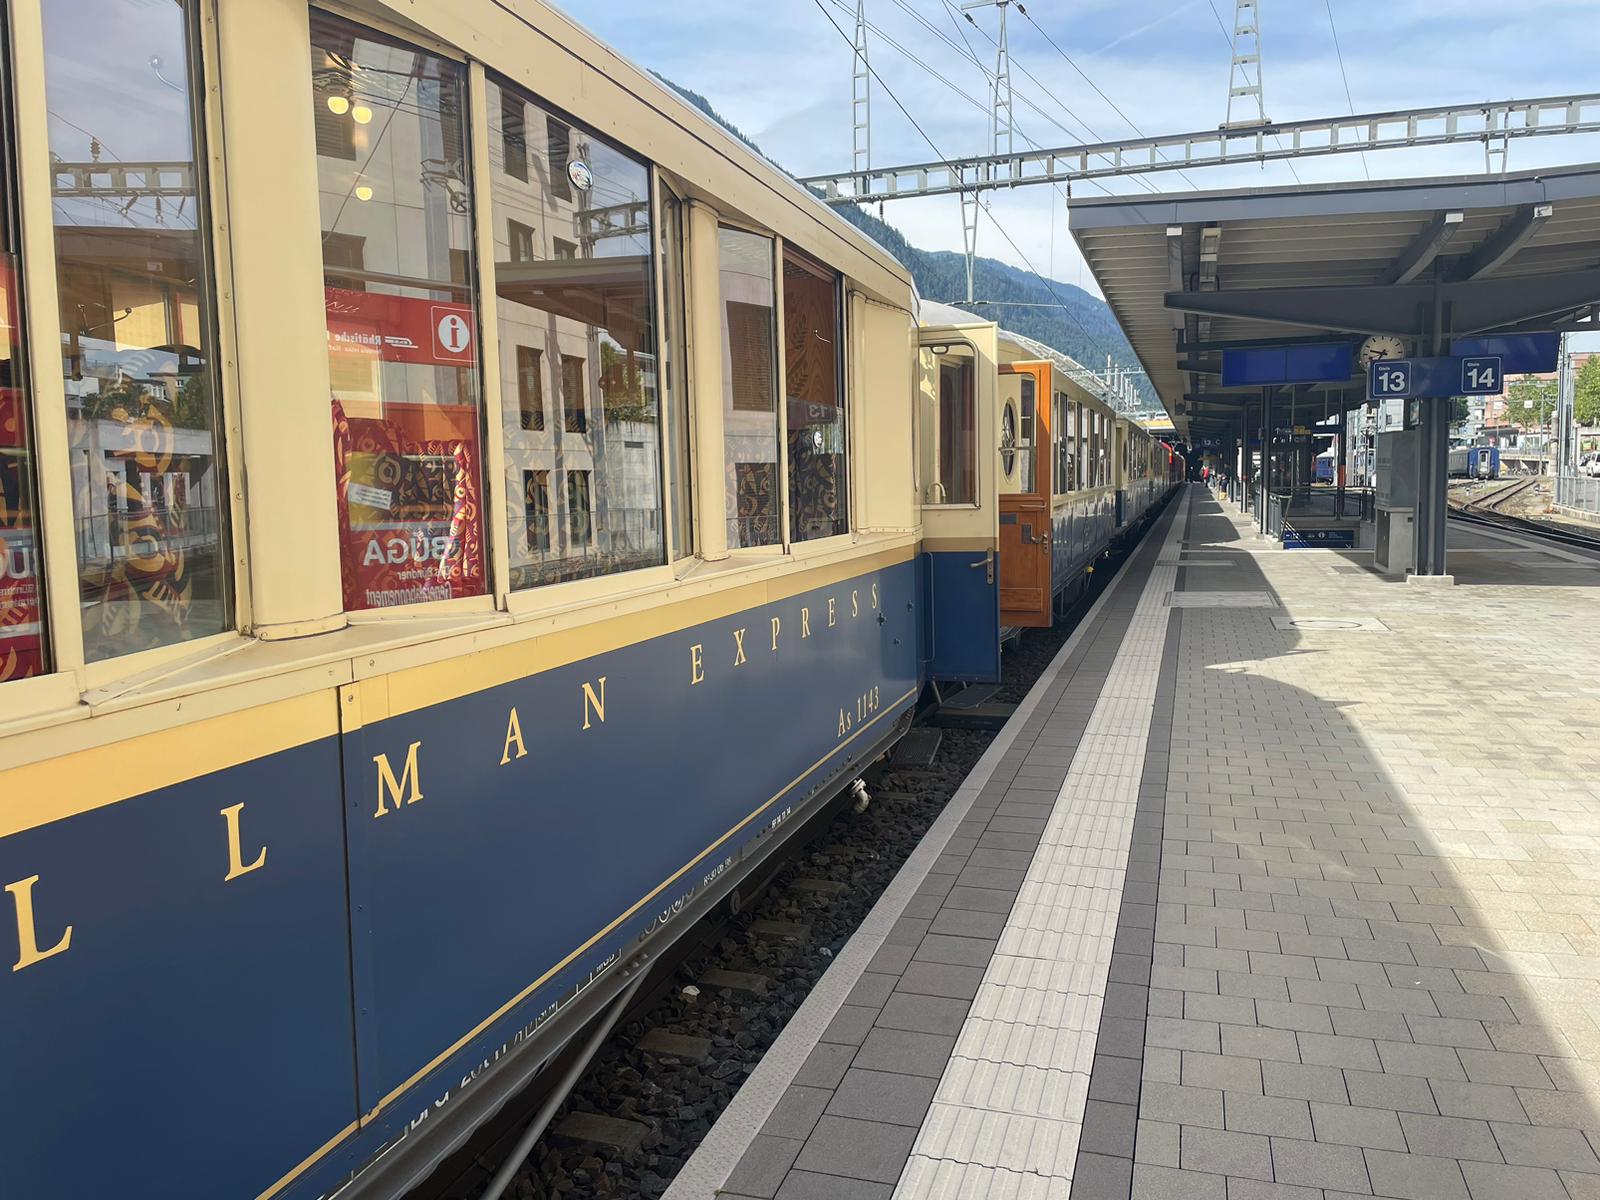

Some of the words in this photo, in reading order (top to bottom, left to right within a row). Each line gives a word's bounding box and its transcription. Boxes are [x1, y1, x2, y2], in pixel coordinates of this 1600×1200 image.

[1379, 372, 1406, 392] 13
[1467, 368, 1495, 388] 14
[690, 583, 878, 685] EXPRESS
[838, 707, 851, 737] As
[856, 686, 880, 722] 1143
